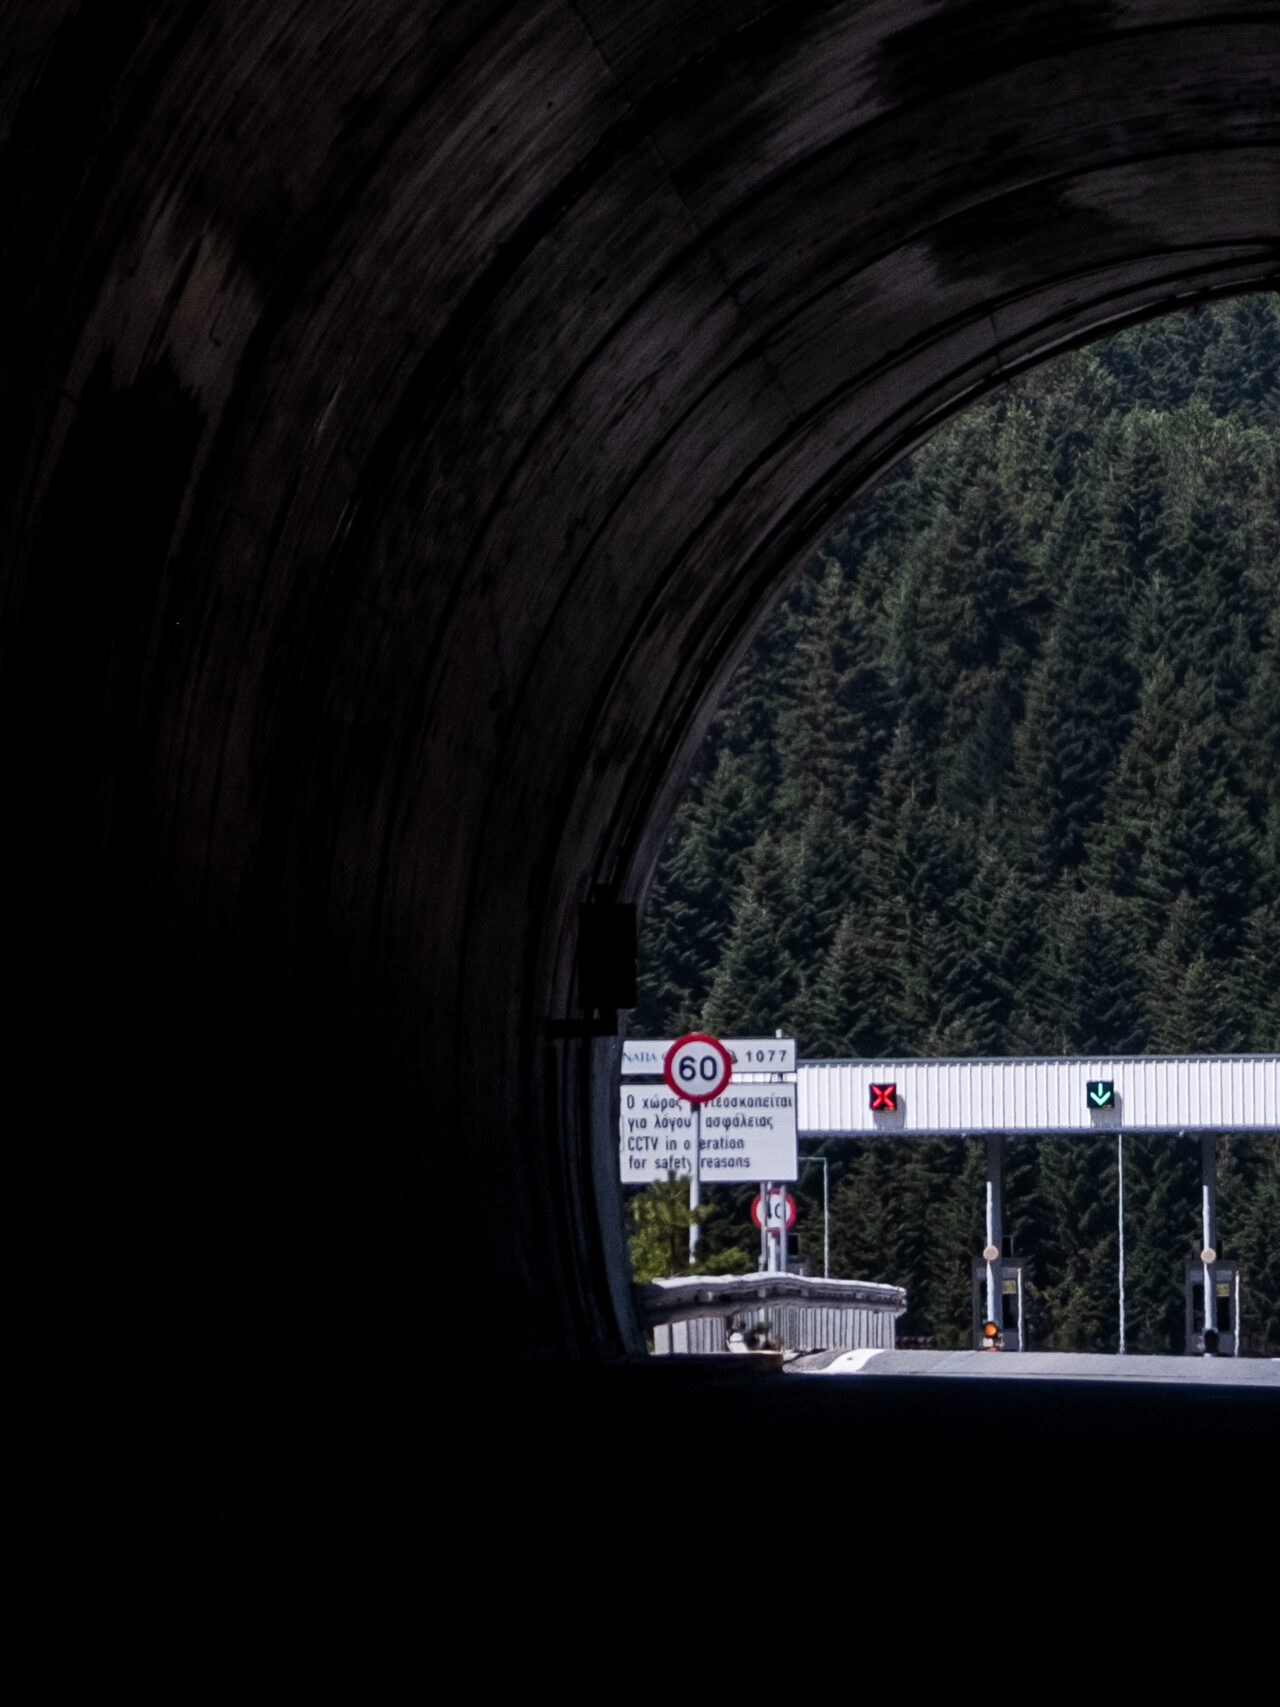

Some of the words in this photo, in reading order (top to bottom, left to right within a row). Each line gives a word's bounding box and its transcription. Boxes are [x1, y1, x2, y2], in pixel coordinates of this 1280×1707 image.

[745, 1050, 787, 1063] 1077
[679, 1055, 717, 1082] 60
[628, 1117, 647, 1133] για
[654, 1112, 692, 1133] λόγου
[705, 1113, 773, 1132] ασφάλειας
[627, 1136, 659, 1151] CCTV
[666, 1135, 678, 1151] in
[684, 1136, 745, 1151] oeration
[629, 1155, 648, 1170] for
[701, 1156, 751, 1169] reasons
